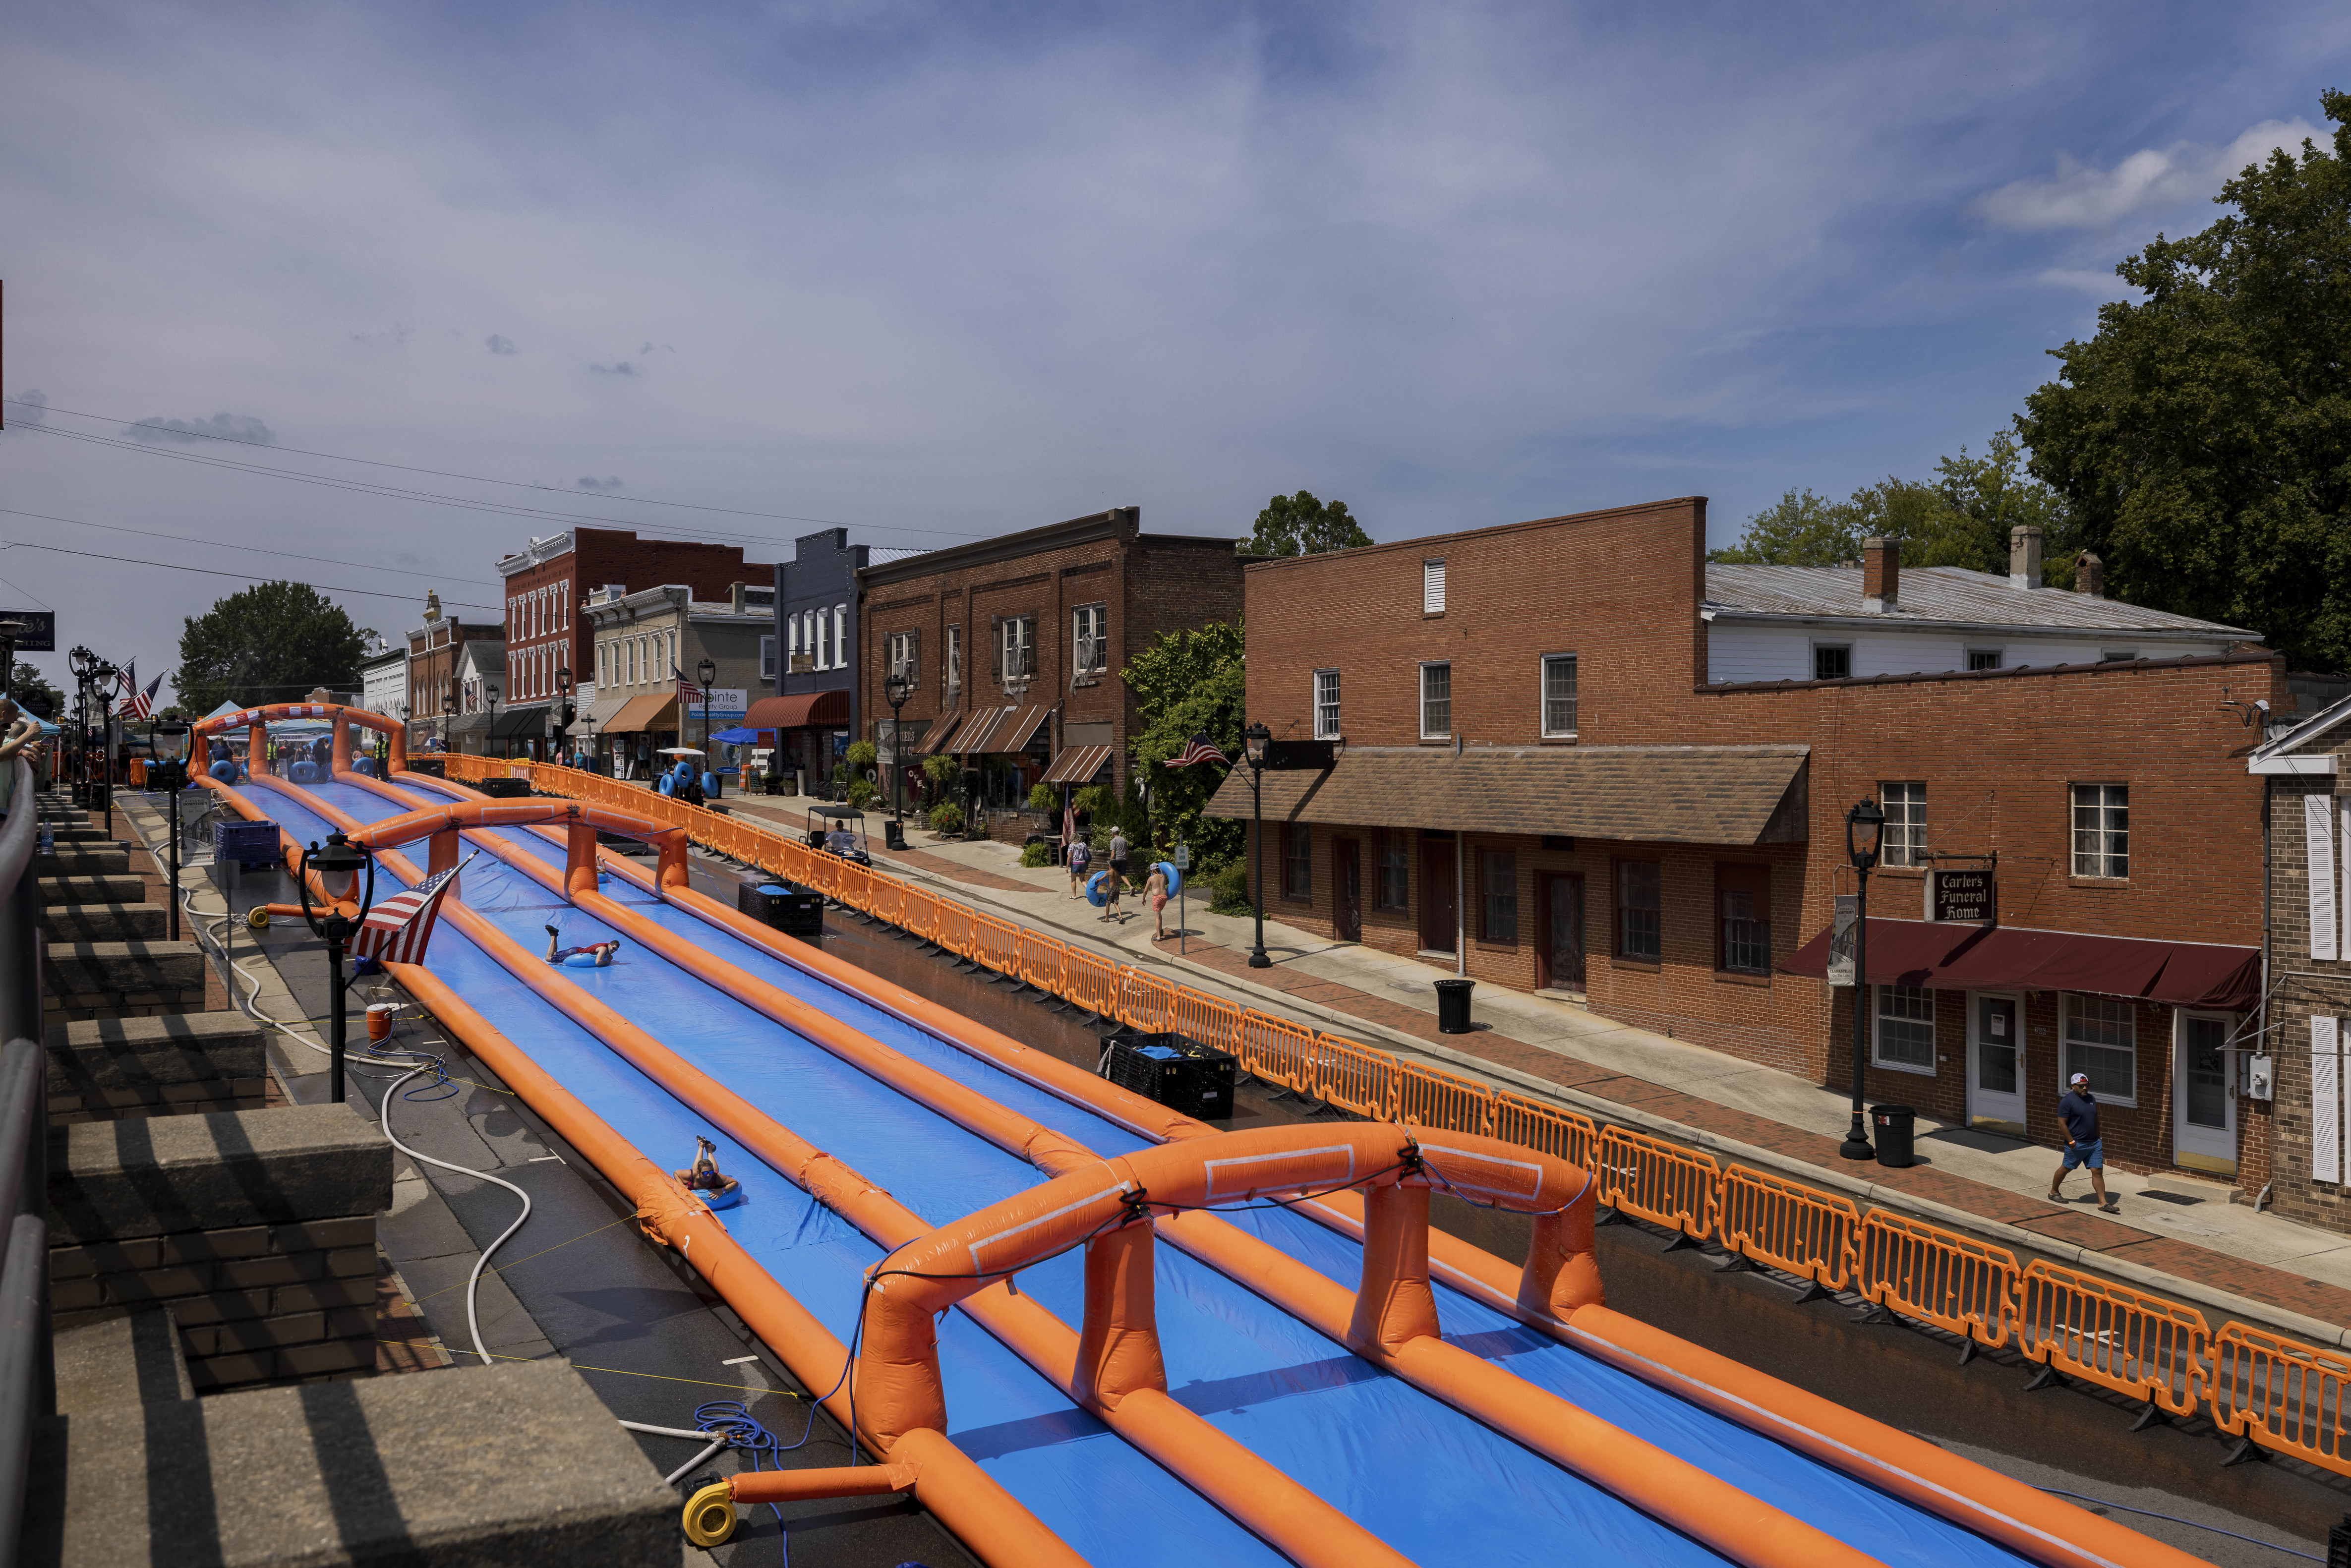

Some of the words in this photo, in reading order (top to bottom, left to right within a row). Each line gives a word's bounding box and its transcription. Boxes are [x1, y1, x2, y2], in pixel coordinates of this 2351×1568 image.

[908, 770, 925, 788] OPE
[1942, 874, 1983, 888] Carter's
[1940, 888, 1986, 904] Funeral
[1944, 906, 1980, 919] Home
[2035, 1027, 2046, 1035] 206
